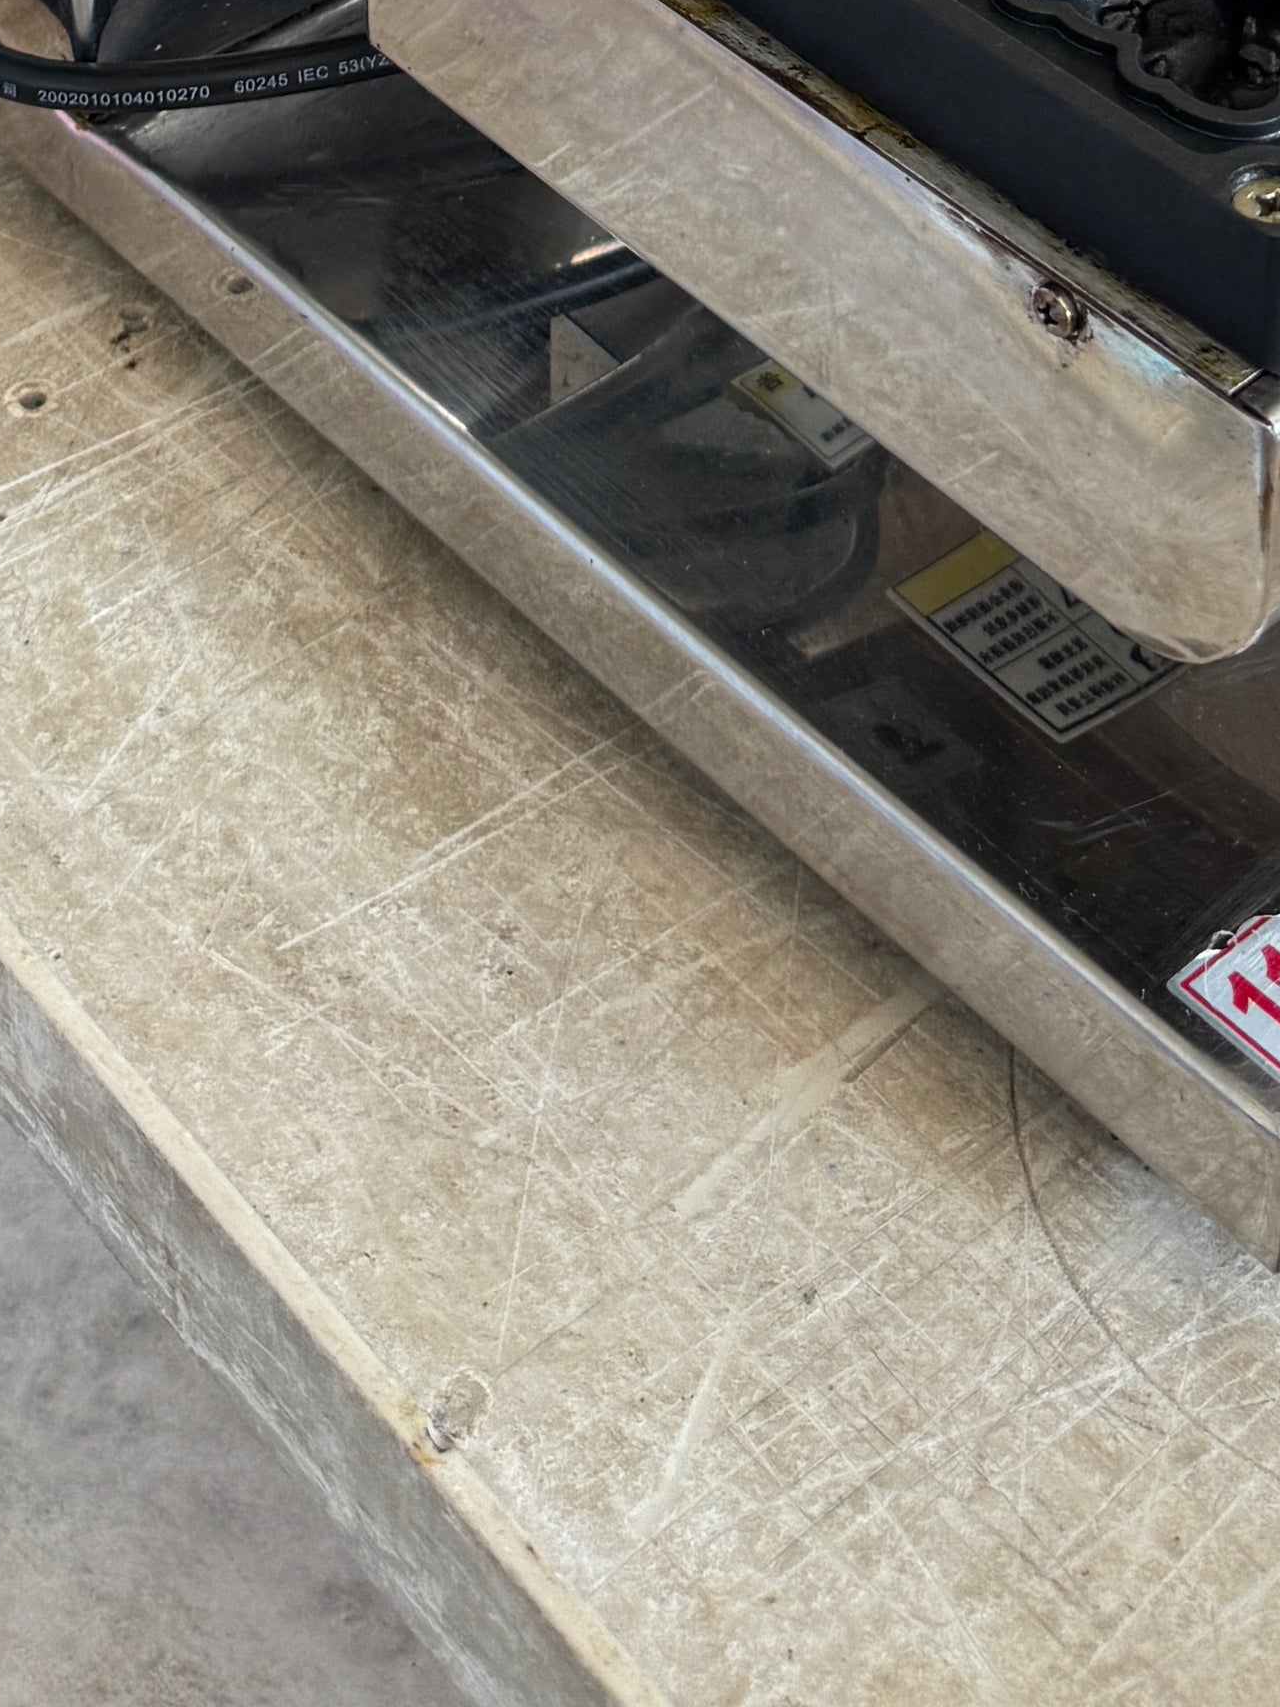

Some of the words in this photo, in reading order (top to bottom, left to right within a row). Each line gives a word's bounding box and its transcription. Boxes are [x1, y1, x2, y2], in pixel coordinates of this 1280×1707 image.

[36, 85, 211, 107] 2002010104010270
[234, 72, 288, 94] 60245
[298, 65, 329, 84] IEC
[338, 53, 394, 76] 53(YZ
